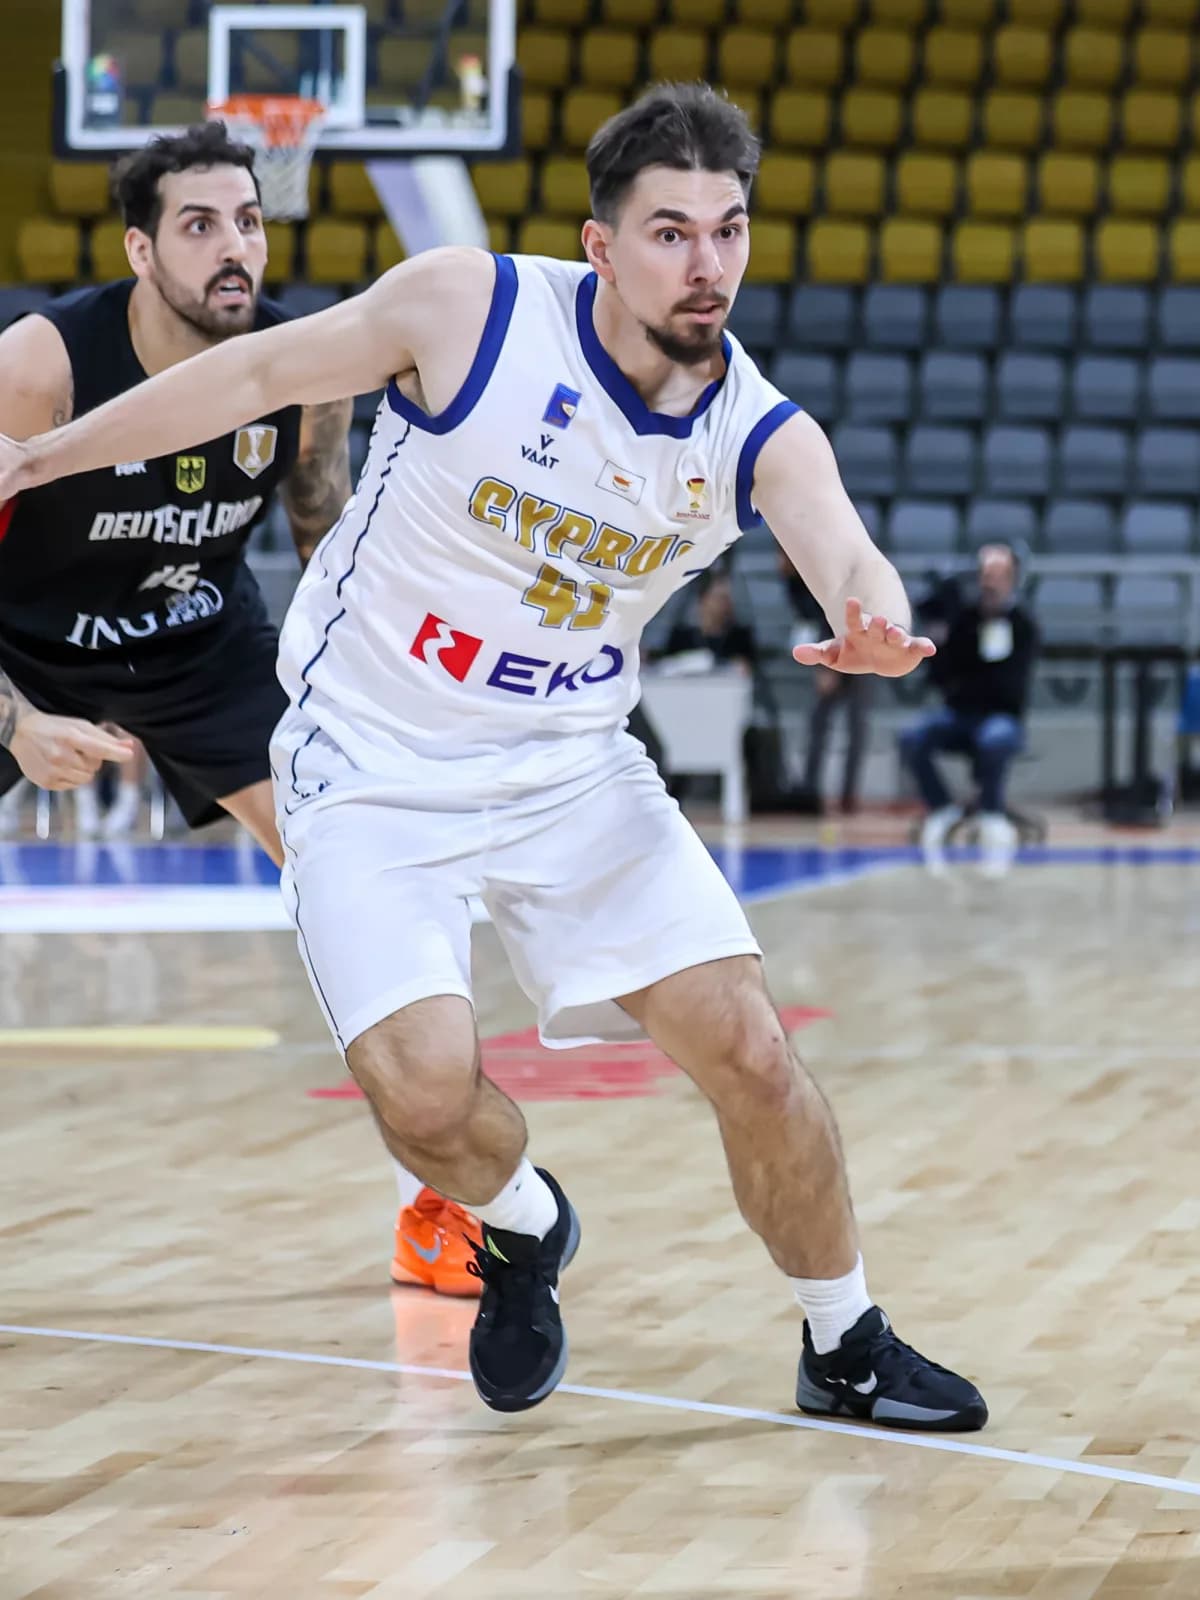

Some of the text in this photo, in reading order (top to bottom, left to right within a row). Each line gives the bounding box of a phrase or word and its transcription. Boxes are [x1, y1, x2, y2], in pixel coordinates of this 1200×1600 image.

[521, 444, 560, 470] VAAT
[520, 562, 614, 631] 41
[486, 644, 625, 698] EKO
